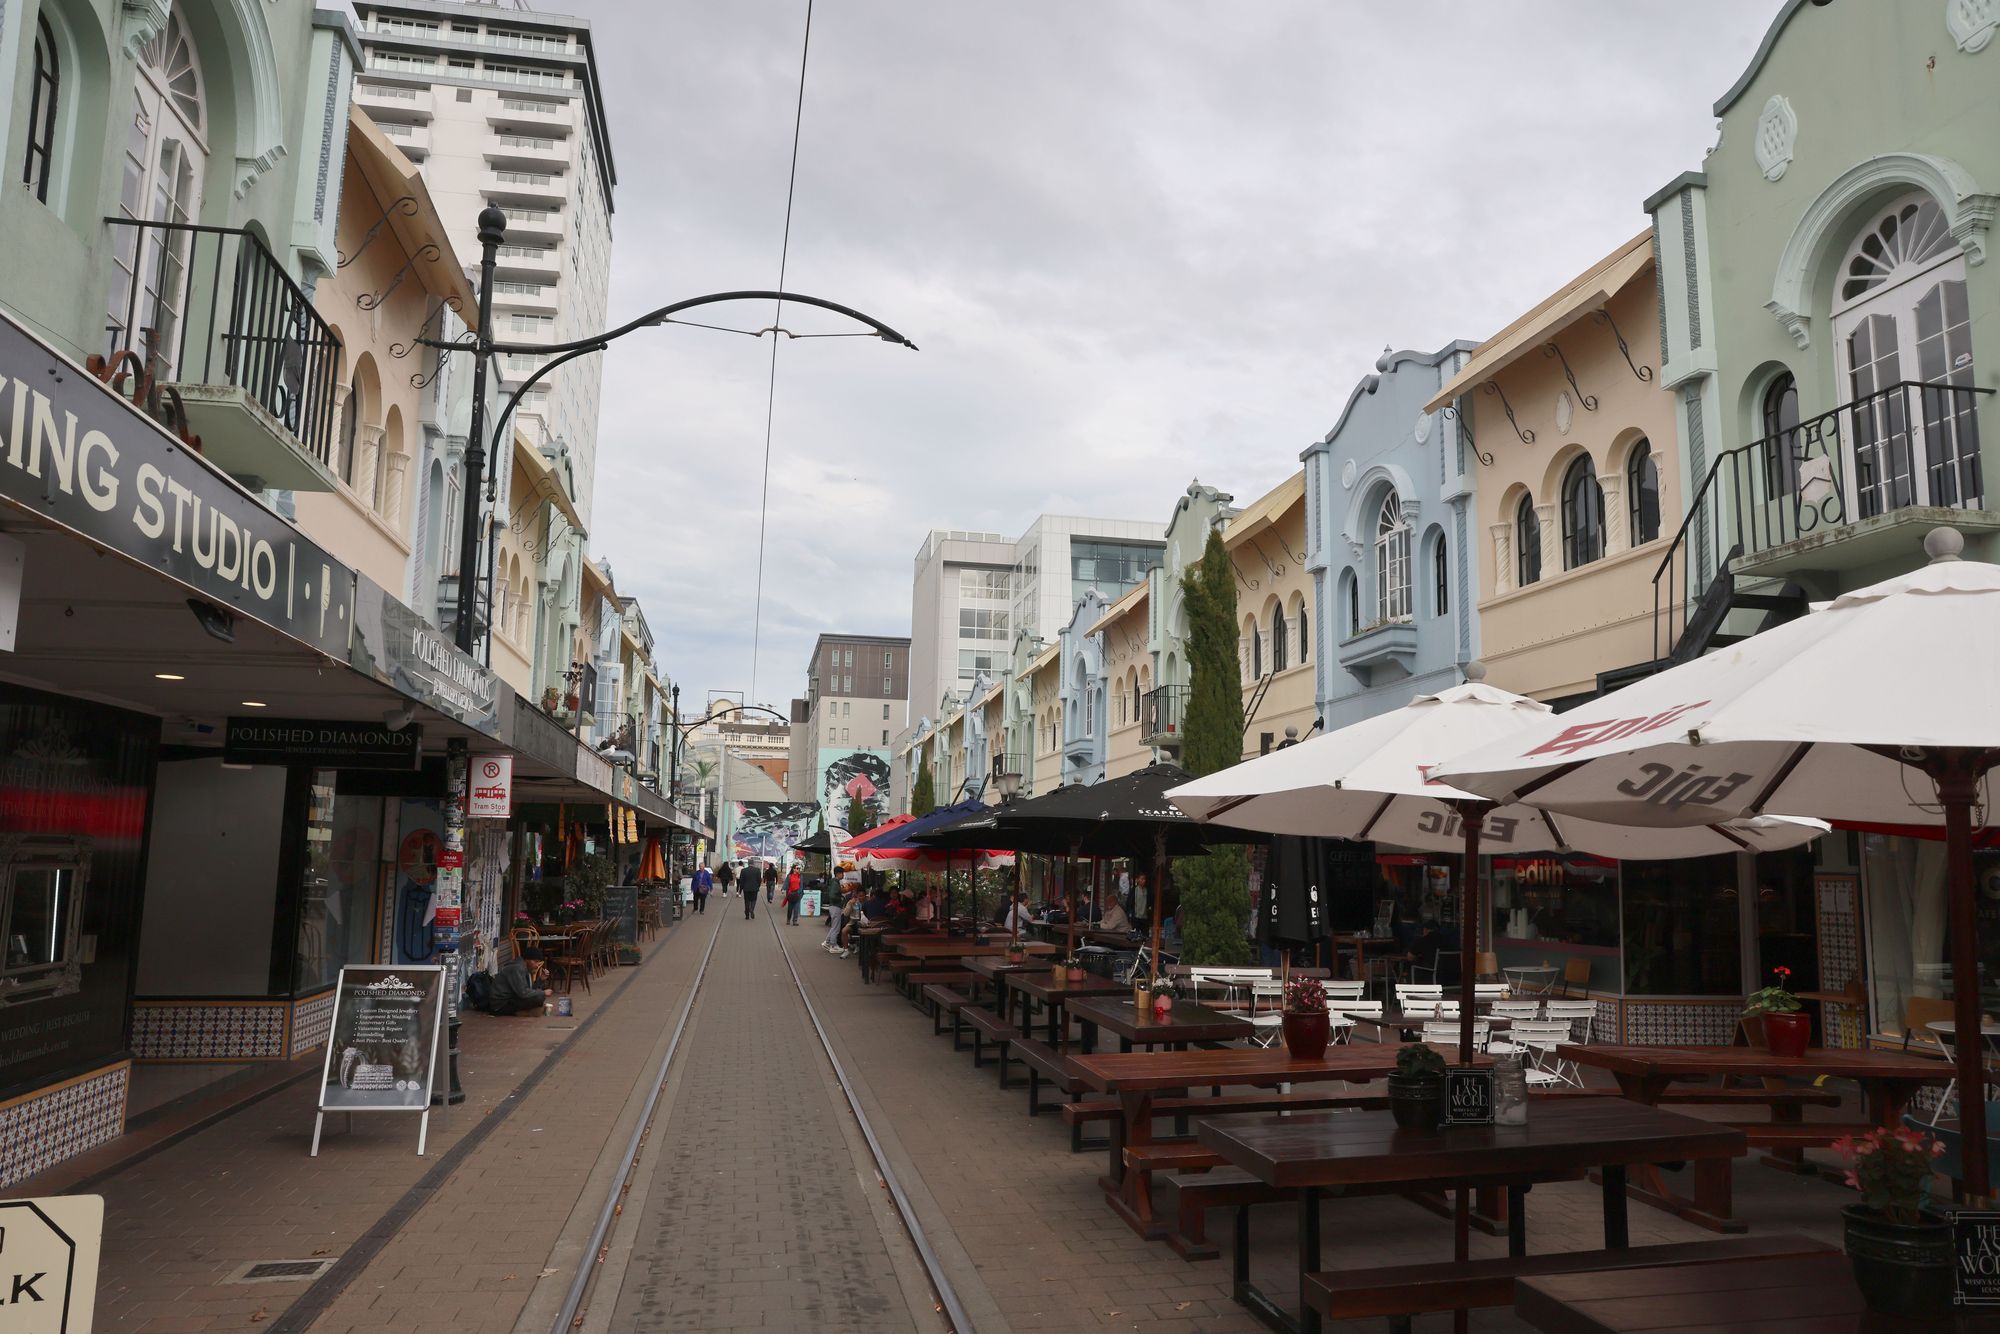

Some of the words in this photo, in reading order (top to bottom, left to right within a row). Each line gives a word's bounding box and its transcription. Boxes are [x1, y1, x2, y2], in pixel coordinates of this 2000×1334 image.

[0, 373, 119, 512] ING
[133, 462, 276, 600] STUDIO
[412, 628, 453, 677] POLISHED
[453, 657, 490, 702] DIAMONDS
[231, 727, 314, 743] POLISHED
[320, 729, 413, 746] DIAMONDS
[1517, 699, 1712, 757] Epic
[490, 803, 506, 811] Stop
[1515, 859, 1564, 885] edith
[1456, 1085, 1484, 1097] LAST
[1462, 1077, 1478, 1086] THE
[0, 1272, 47, 1305] K
